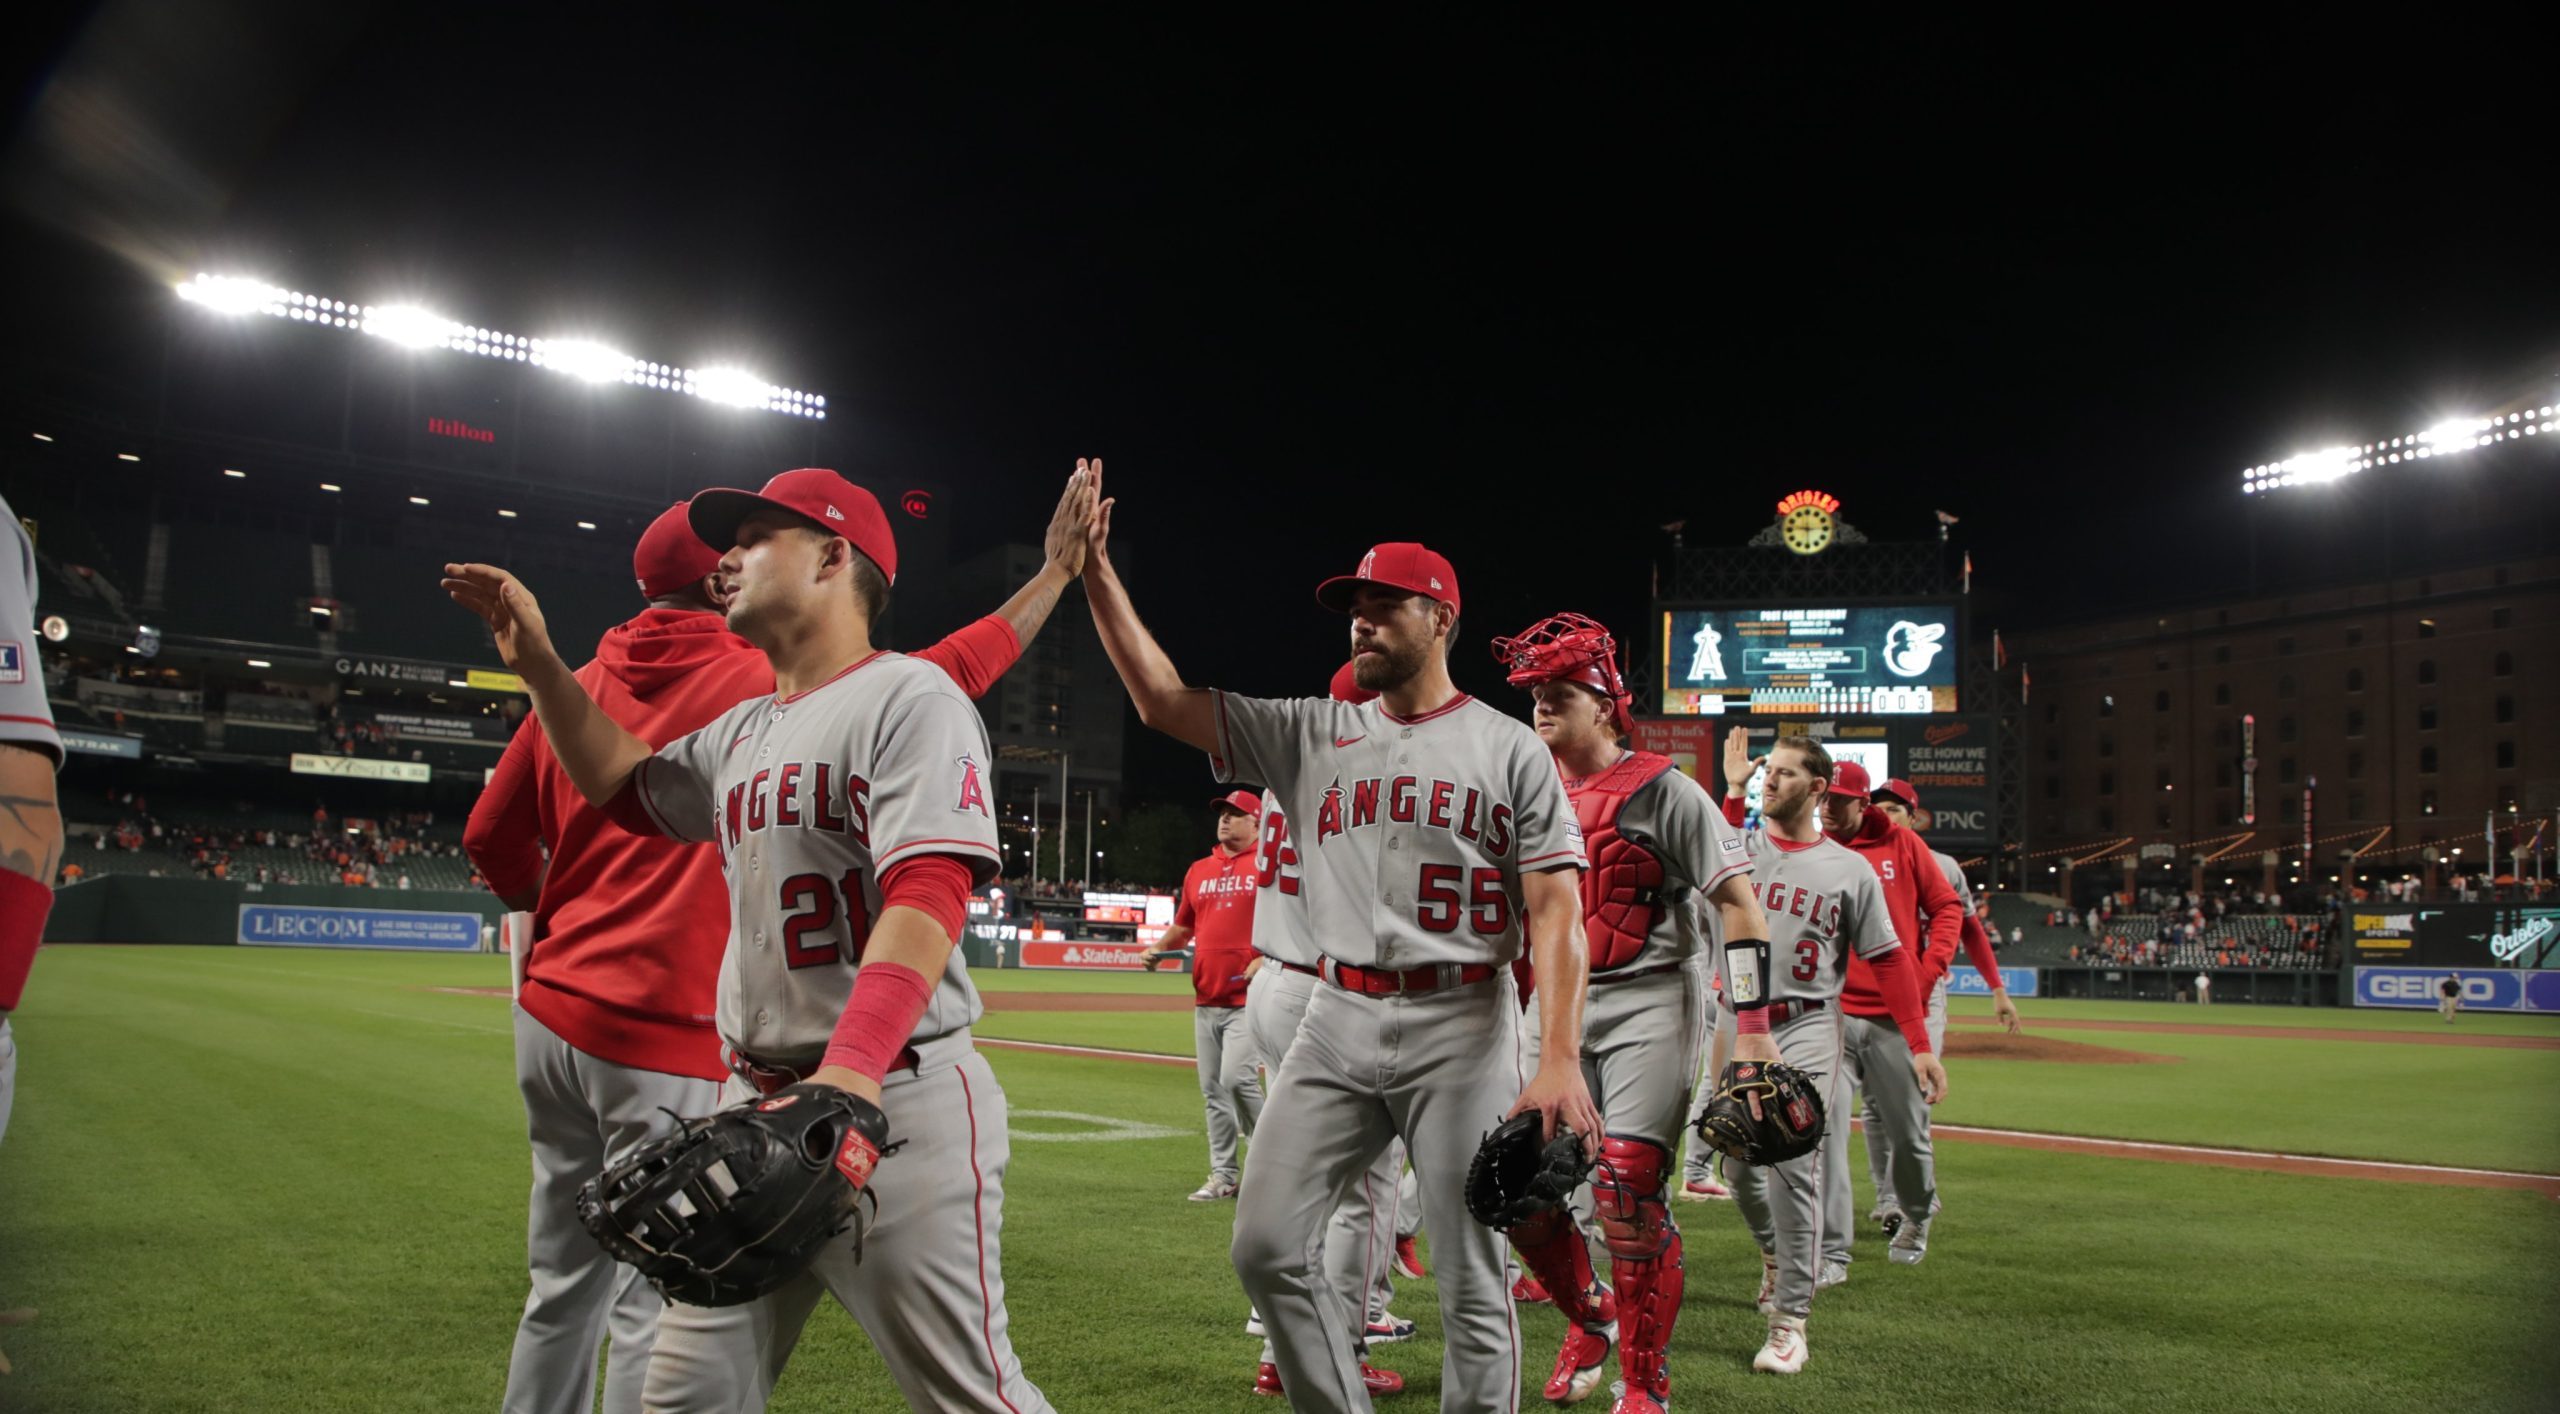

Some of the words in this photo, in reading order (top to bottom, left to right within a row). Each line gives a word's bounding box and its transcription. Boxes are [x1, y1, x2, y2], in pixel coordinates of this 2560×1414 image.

[428, 417, 495, 443] Hilton
[1777, 490, 1840, 515] ORIOLES
[335, 658, 400, 679] GANZ
[1639, 725, 1668, 737] This
[62, 737, 120, 752] MTRAK
[1647, 739, 1668, 750] For
[1908, 747, 1932, 759] SEE
[1934, 747, 1965, 759] HOW
[1966, 747, 1986, 759] WE
[1909, 761, 1935, 772] CAN
[1937, 761, 1973, 772] MAKE
[1975, 761, 1984, 772] A
[952, 752, 990, 819] A
[1909, 774, 1985, 786] DIFFERENCE
[1317, 773, 1514, 858] ANGELS
[1934, 811, 1985, 830] PNC
[1198, 875, 1256, 895] ANGELS
[1417, 862, 1509, 935] 55
[780, 867, 871, 970] 21
[2490, 917, 2554, 959] Orioles
[1792, 939, 1819, 982] 3
